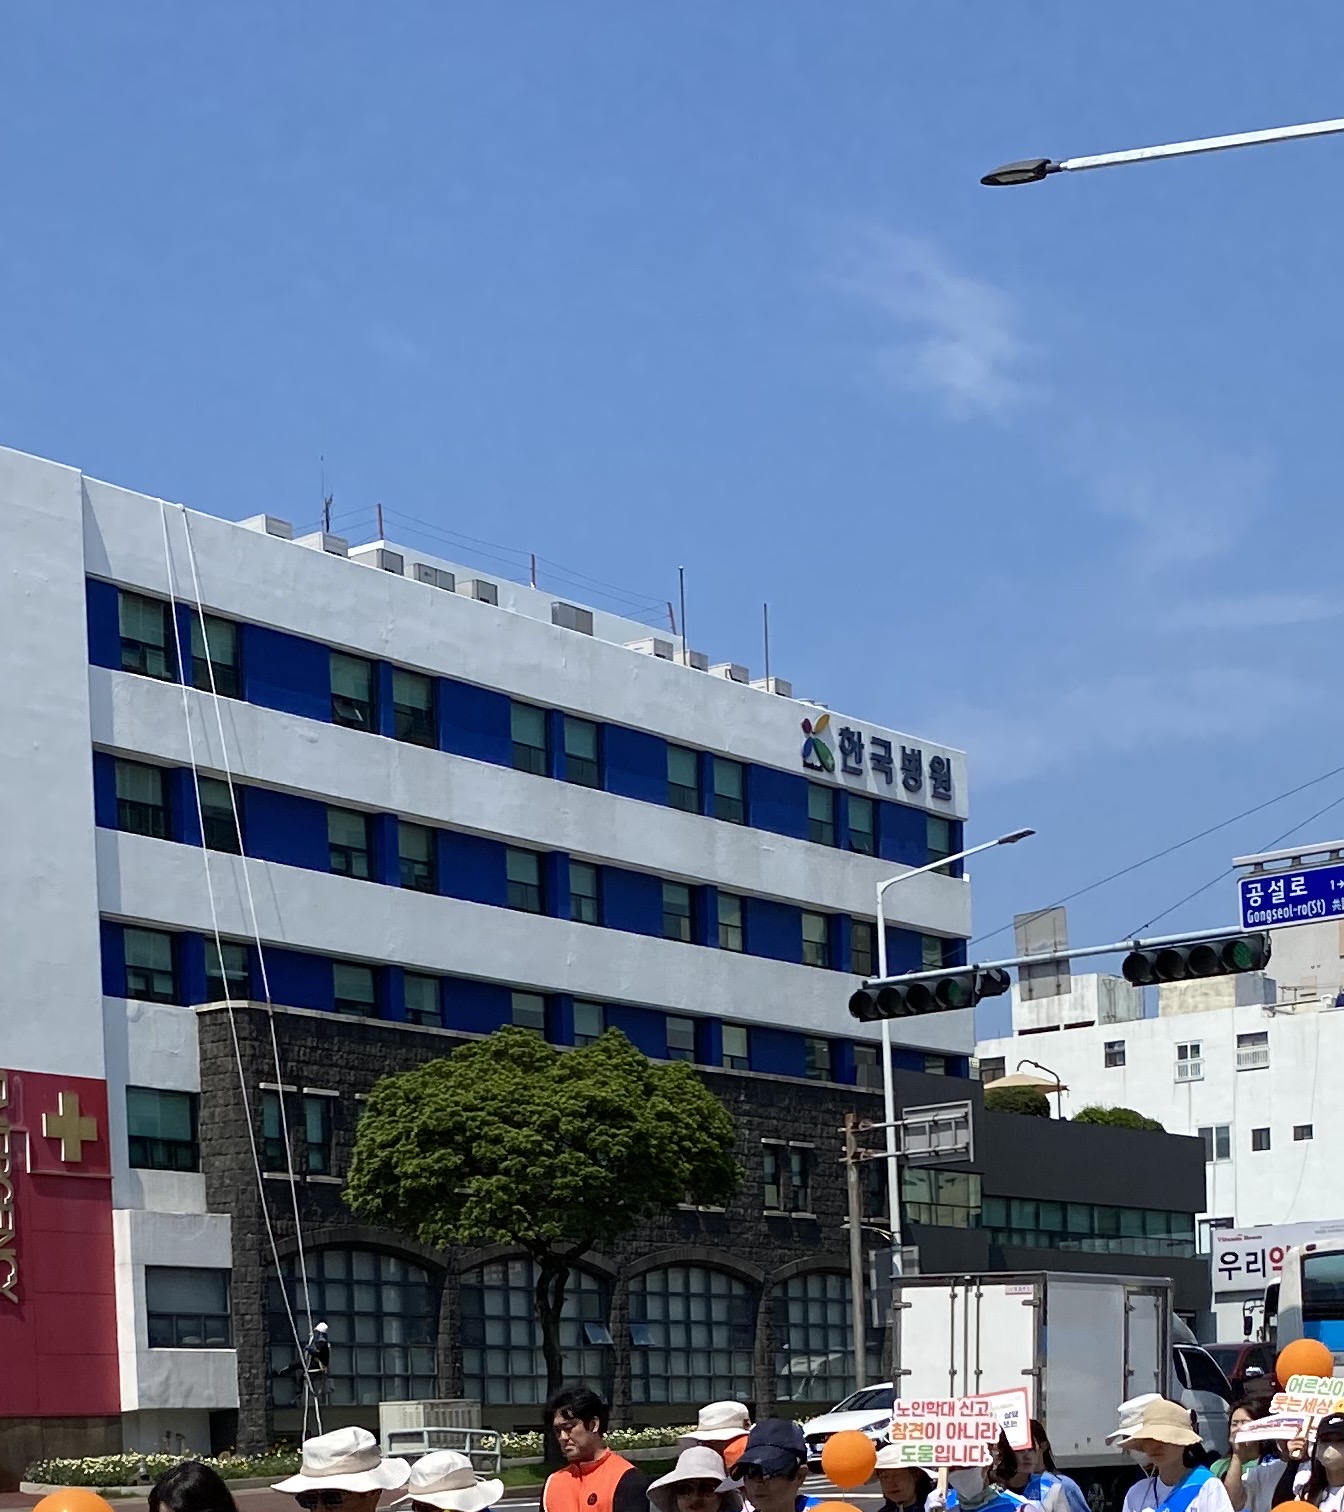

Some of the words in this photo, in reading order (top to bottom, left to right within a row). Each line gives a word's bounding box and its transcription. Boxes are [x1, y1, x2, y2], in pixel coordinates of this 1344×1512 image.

[839, 726, 952, 801] 한국병원
[1246, 876, 1308, 907] 공설로
[1246, 898, 1326, 924] Gongseol-ro(St)
[896, 1401, 955, 1417] 노인학대
[892, 1421, 941, 1440] 참견이
[946, 1421, 998, 1441] 아니라
[900, 1444, 990, 1463] 도움입니다.
